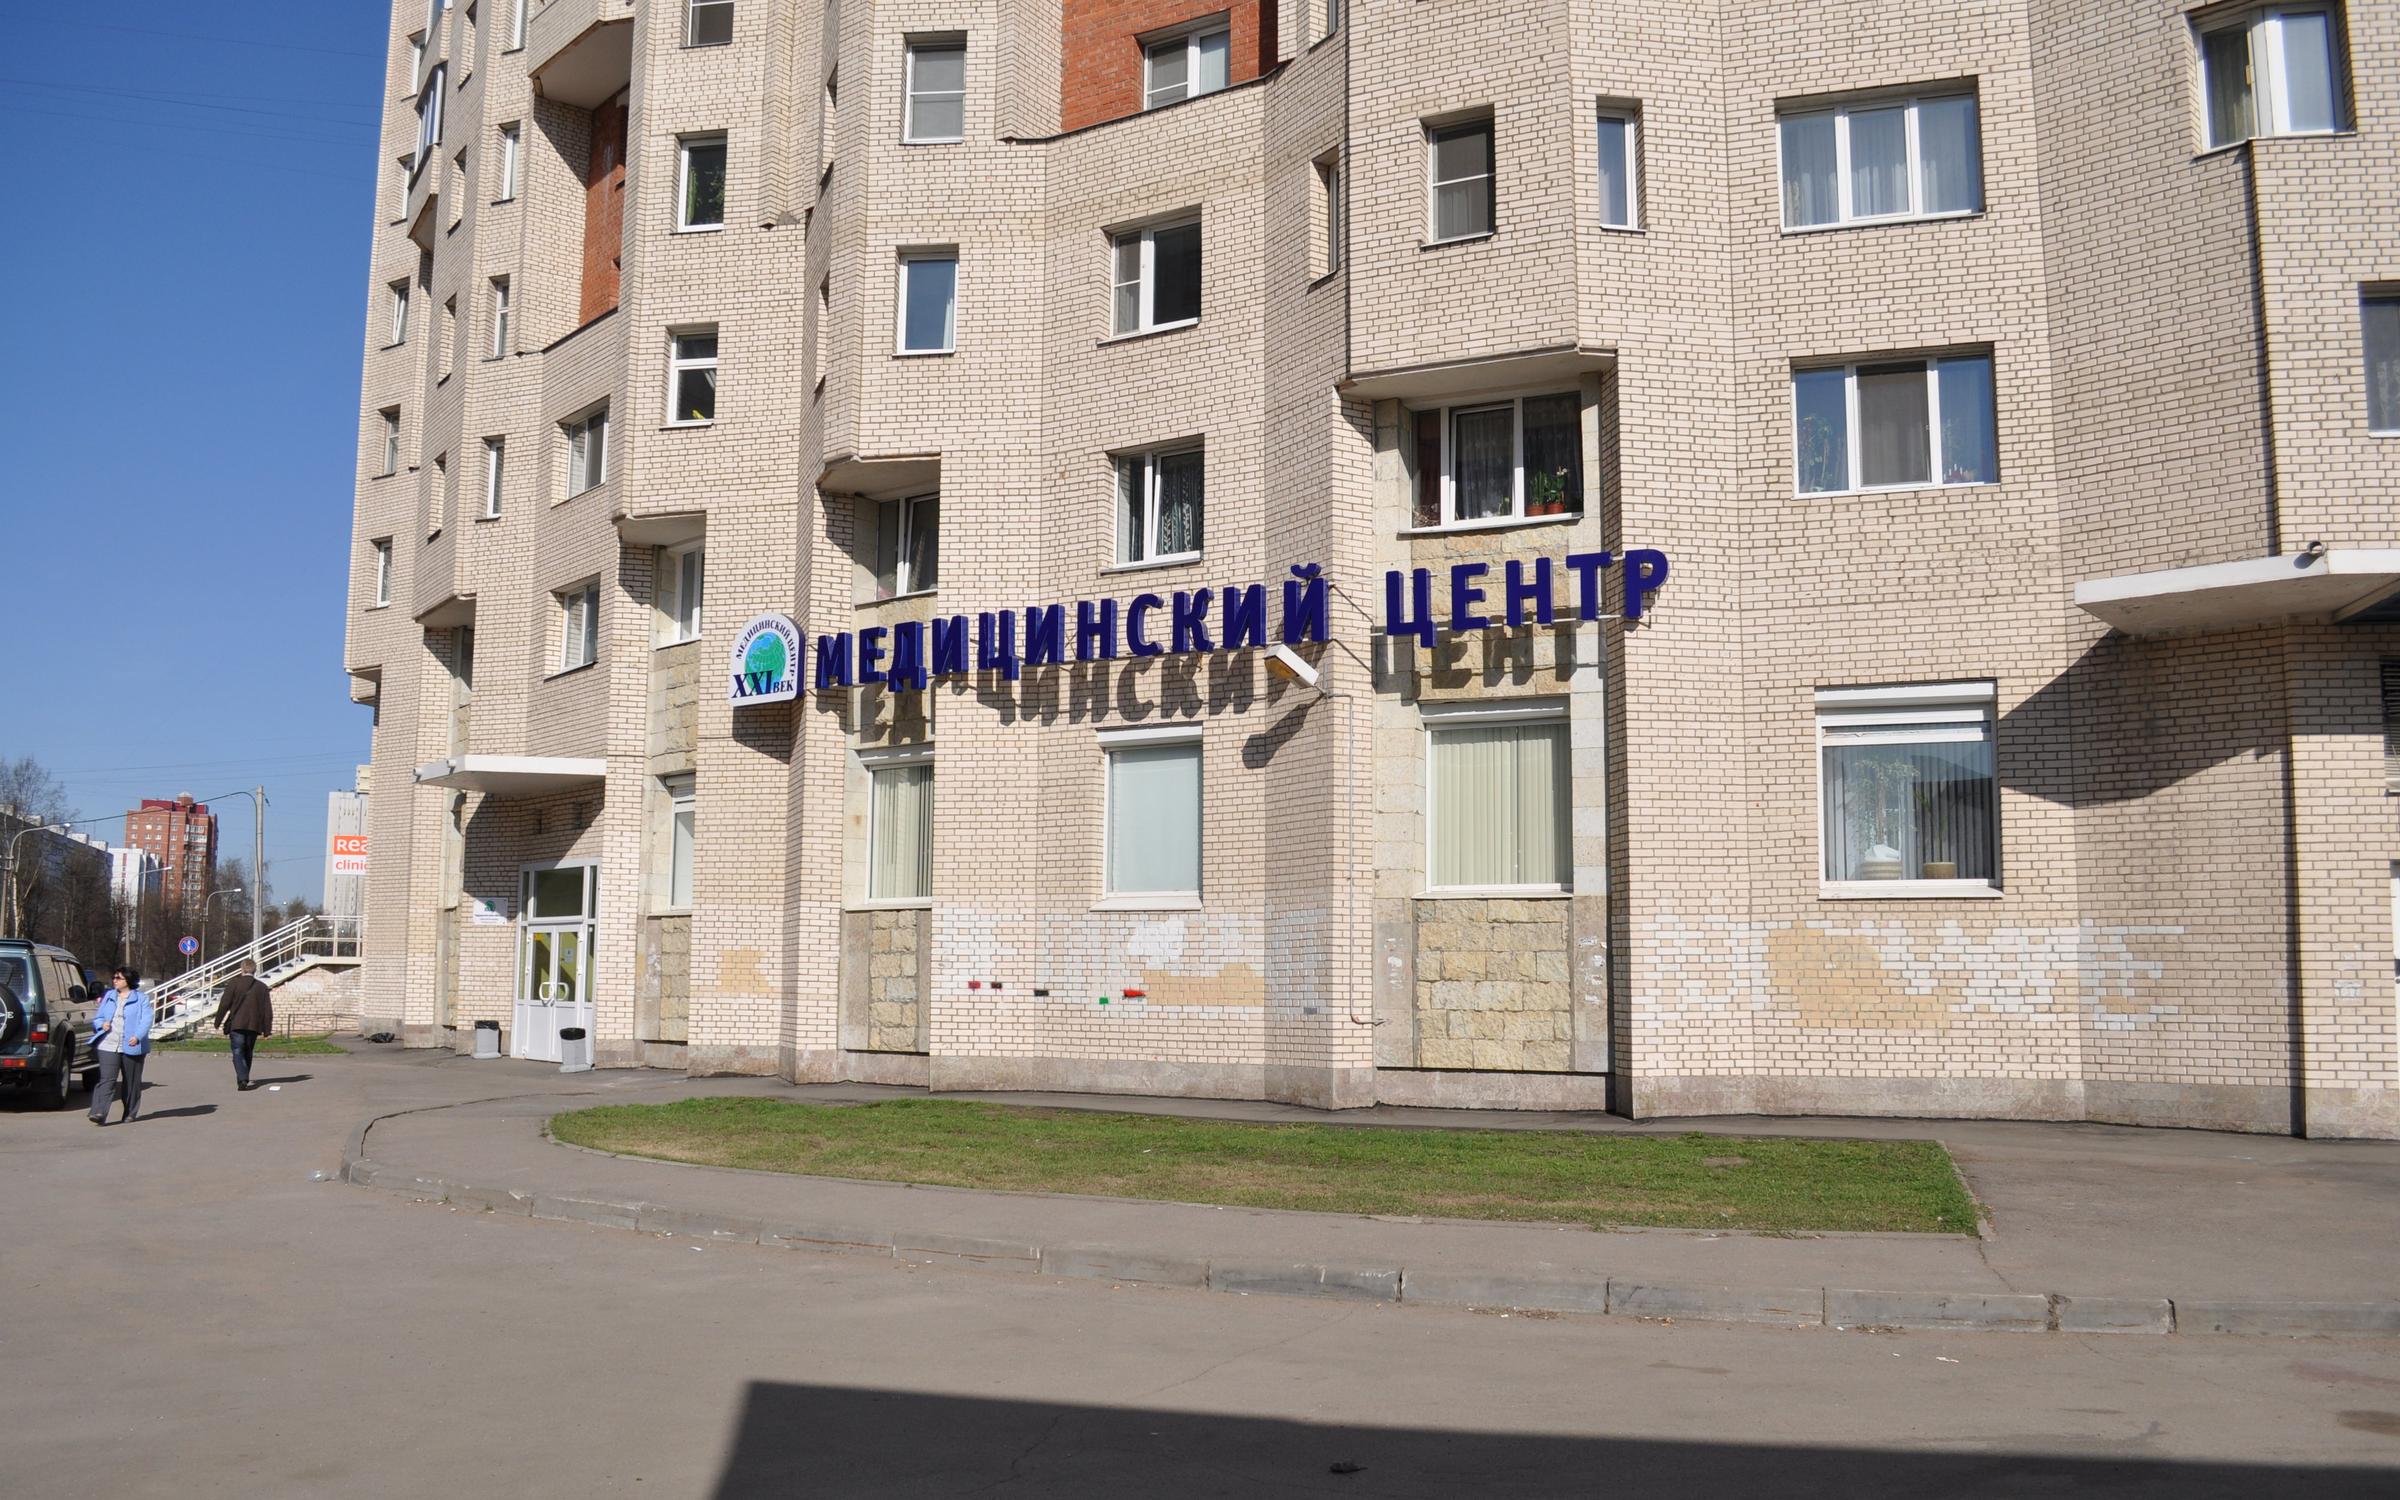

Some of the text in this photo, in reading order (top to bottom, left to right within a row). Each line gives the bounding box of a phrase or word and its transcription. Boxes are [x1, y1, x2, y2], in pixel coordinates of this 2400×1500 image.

[736, 620, 796, 677] МЕДИЦИНСКИЙ ЦЕНТР
[815, 549, 1670, 692] МЕДИЦИНСКИЙ ЦЕНТР
[731, 670, 794, 699] XXI ВЕК
